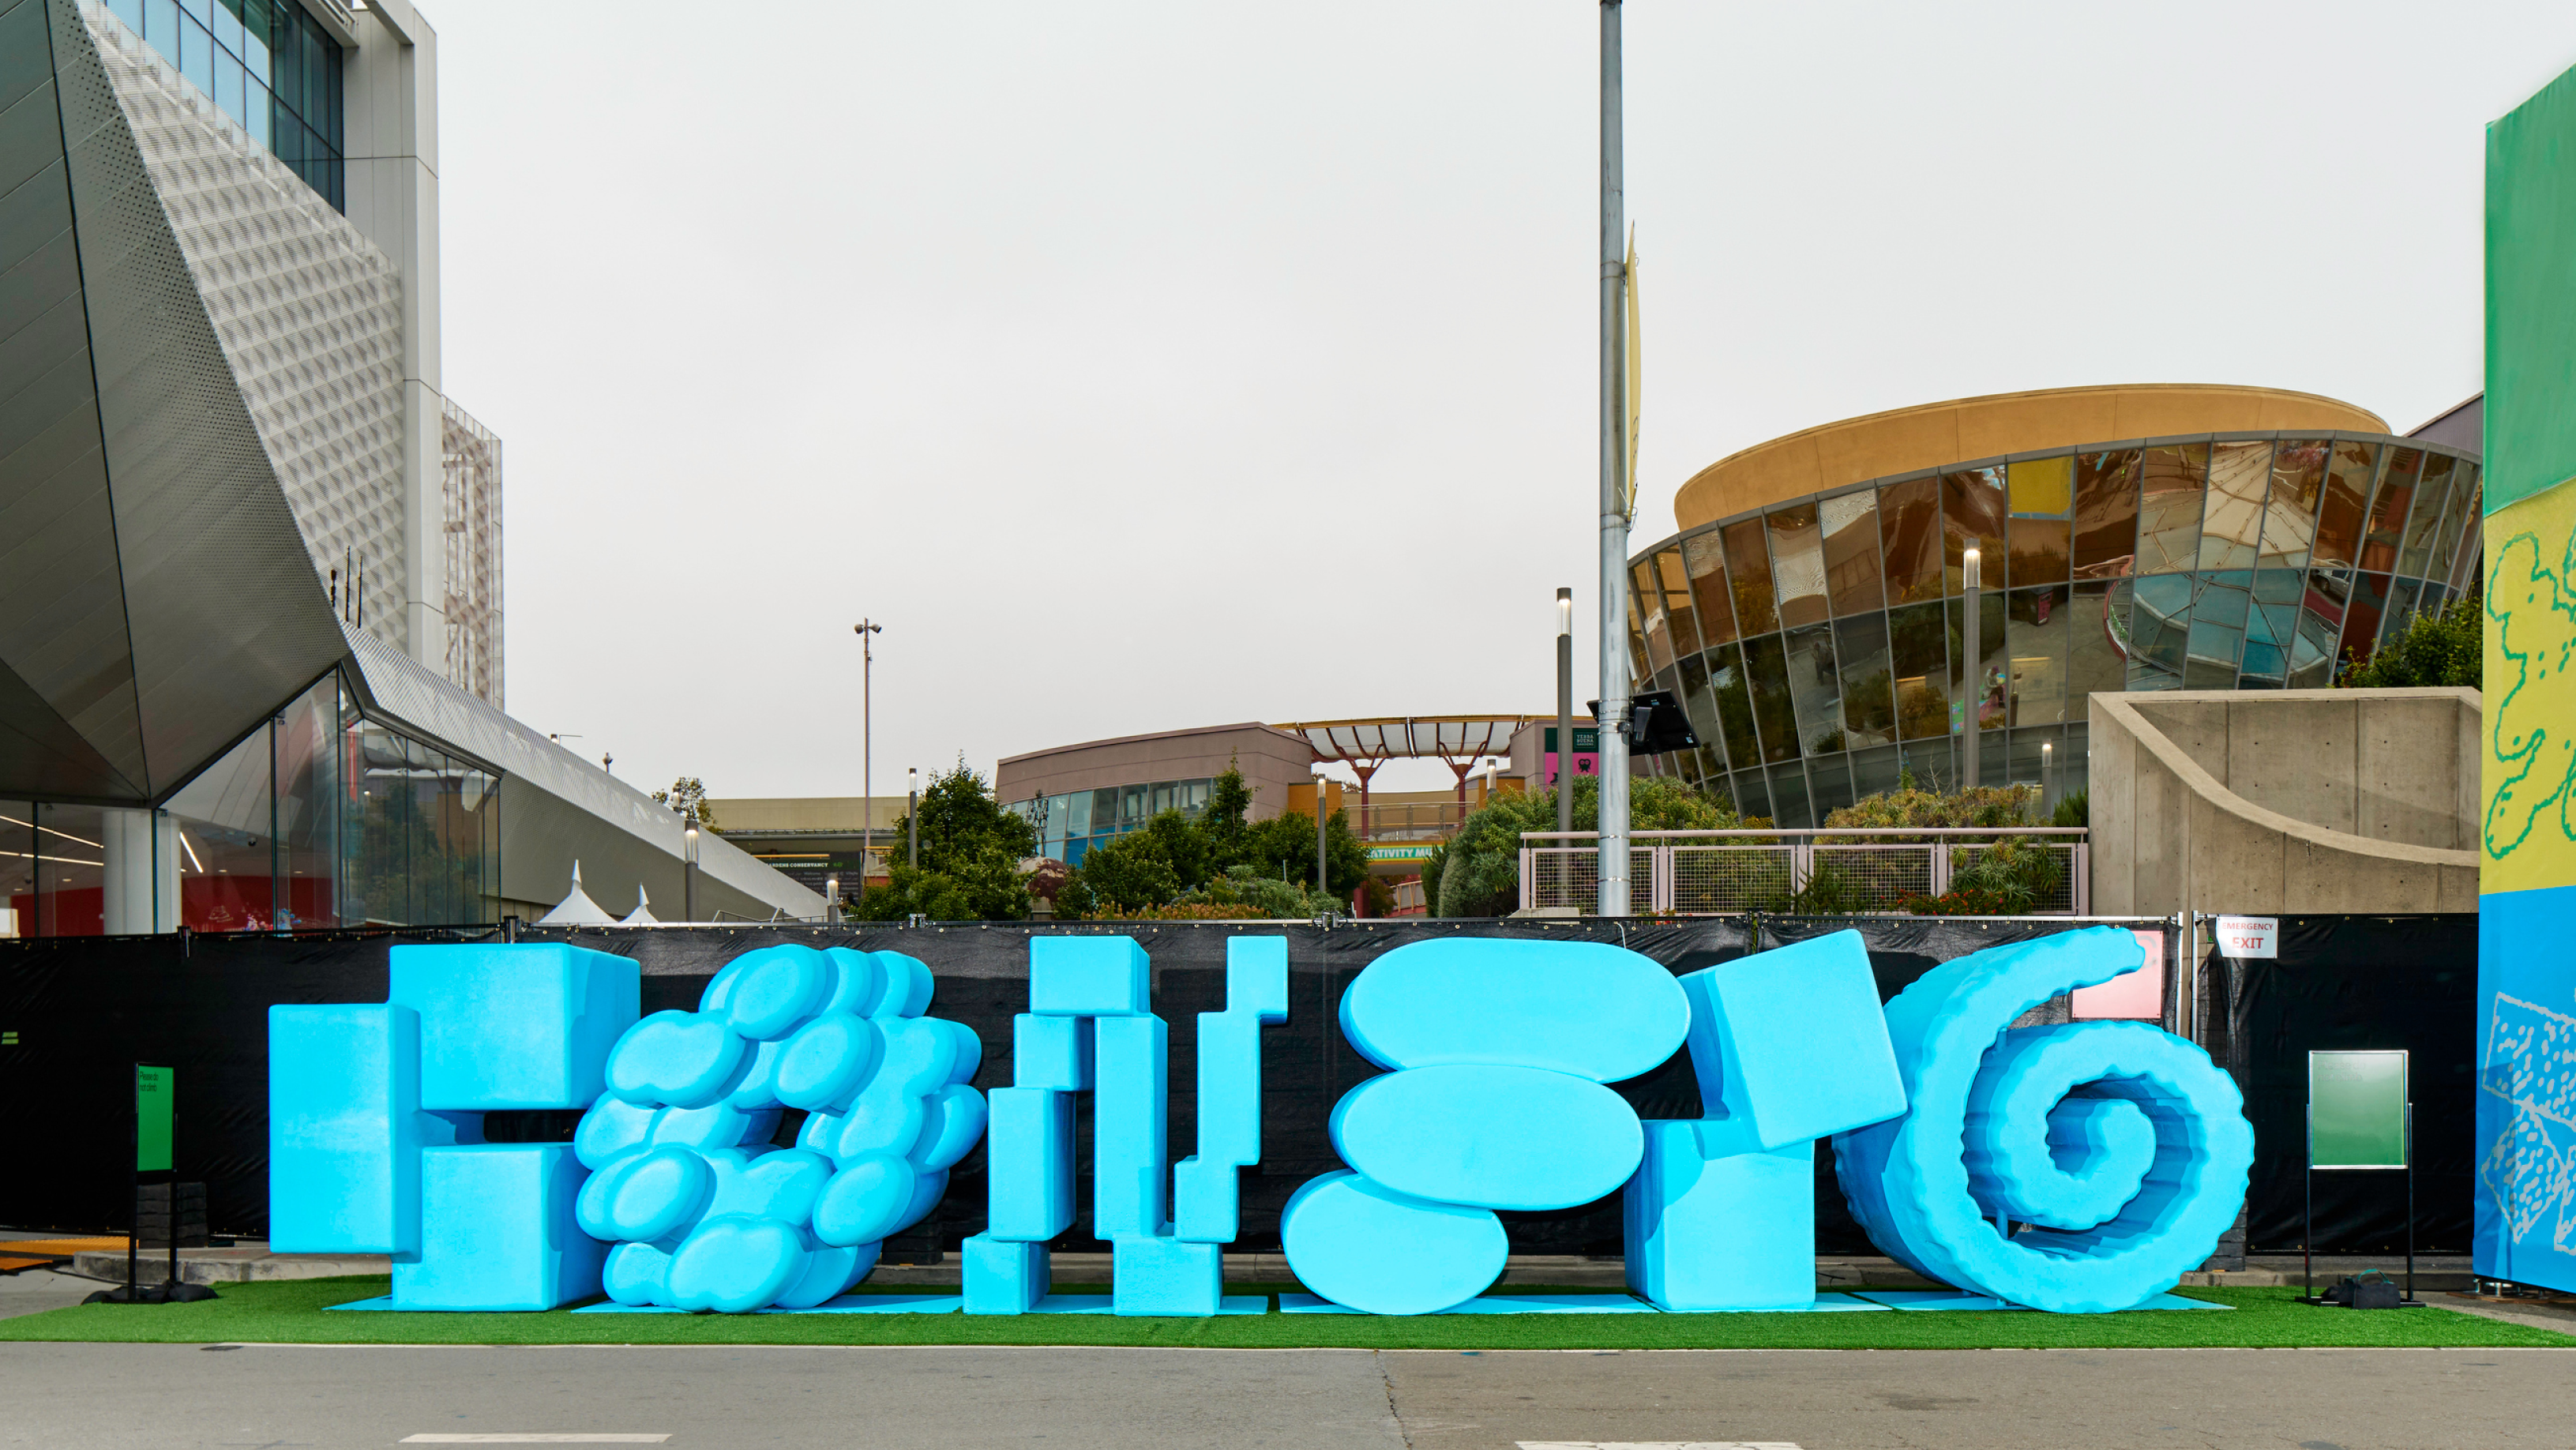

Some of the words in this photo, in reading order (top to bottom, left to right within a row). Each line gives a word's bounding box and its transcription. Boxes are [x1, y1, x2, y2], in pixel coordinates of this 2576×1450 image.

[1371, 849, 1414, 858] ATIVITY
[2232, 937, 2264, 949] EXIT
[2318, 1061, 2351, 1070] Please
[2353, 1061, 2366, 1070] do
[140, 1071, 152, 1081] Please
[153, 1072, 159, 1081] do
[2318, 1073, 2334, 1083] not
[2335, 1072, 2363, 1083] climb
[147, 1082, 157, 1092] climb
